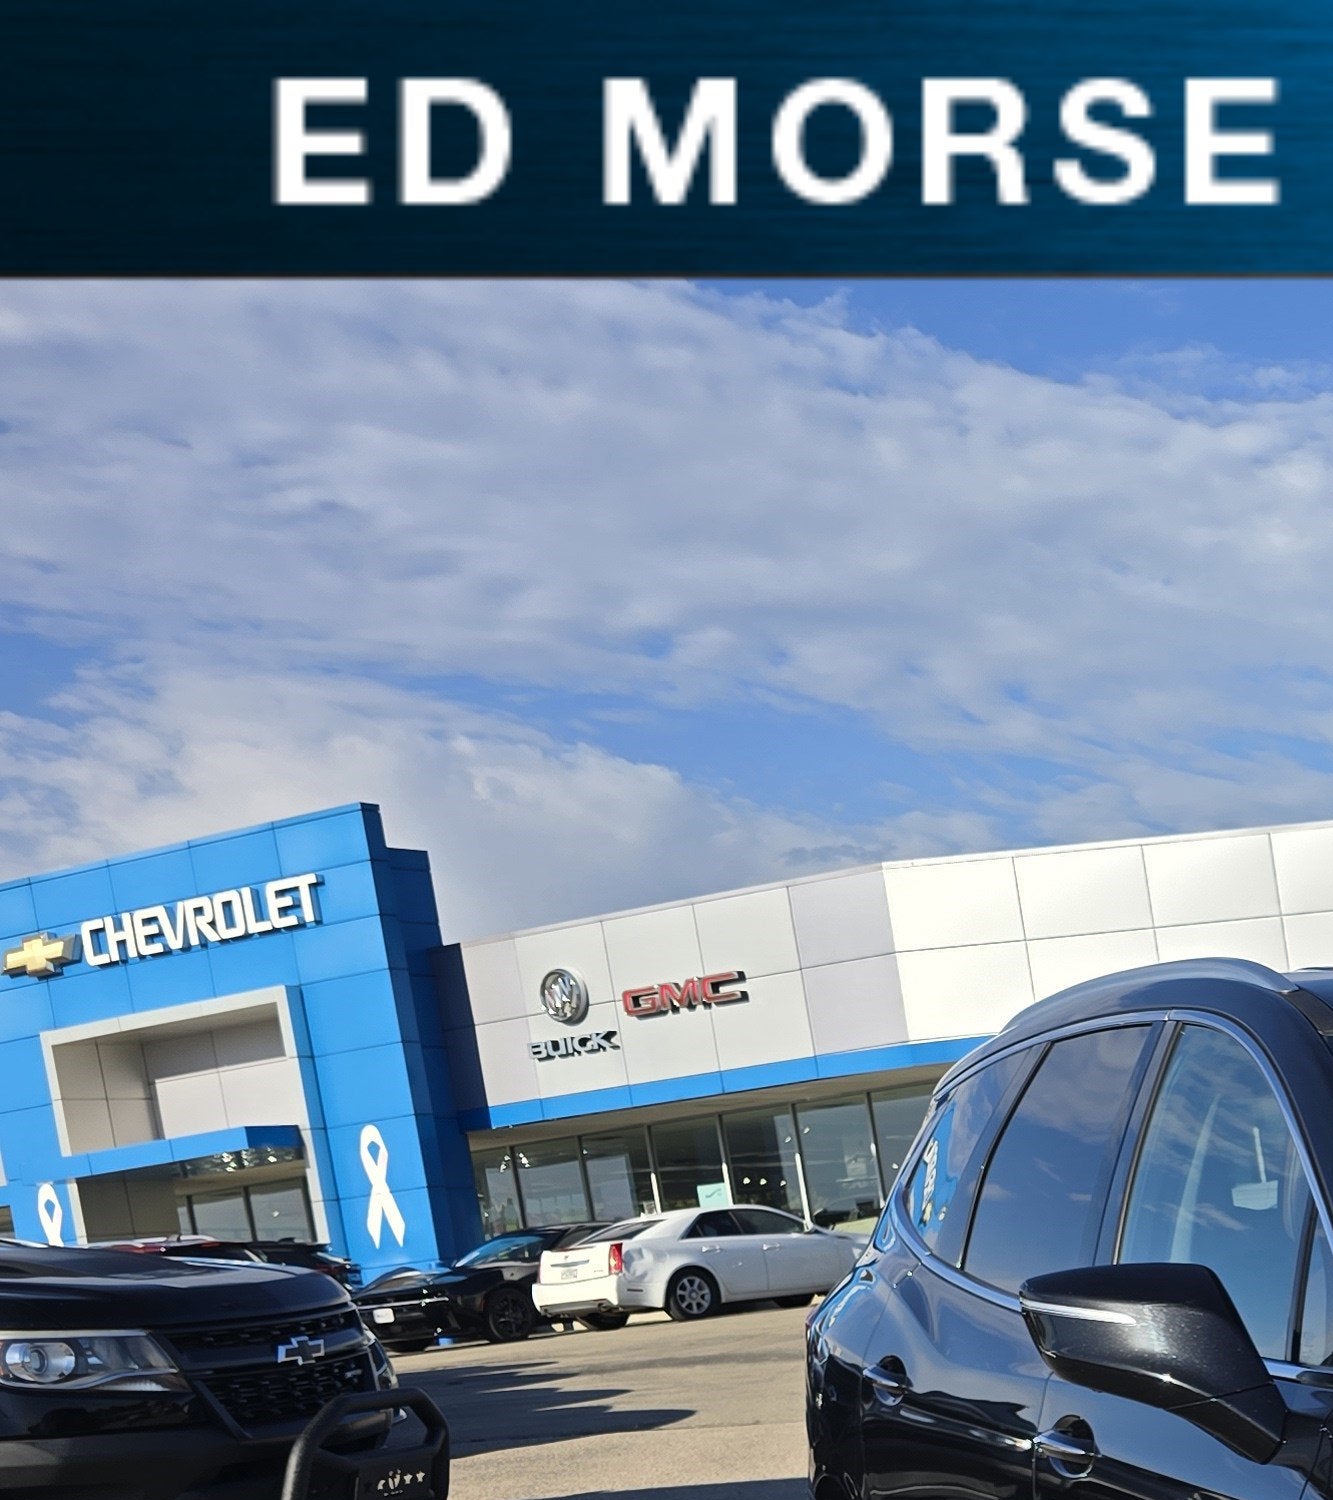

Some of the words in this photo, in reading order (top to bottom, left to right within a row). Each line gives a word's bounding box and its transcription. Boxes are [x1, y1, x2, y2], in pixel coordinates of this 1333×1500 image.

[80, 872, 322, 967] CHEVROLET
[621, 970, 745, 1019] GMC
[527, 1030, 616, 1060] BUICK
